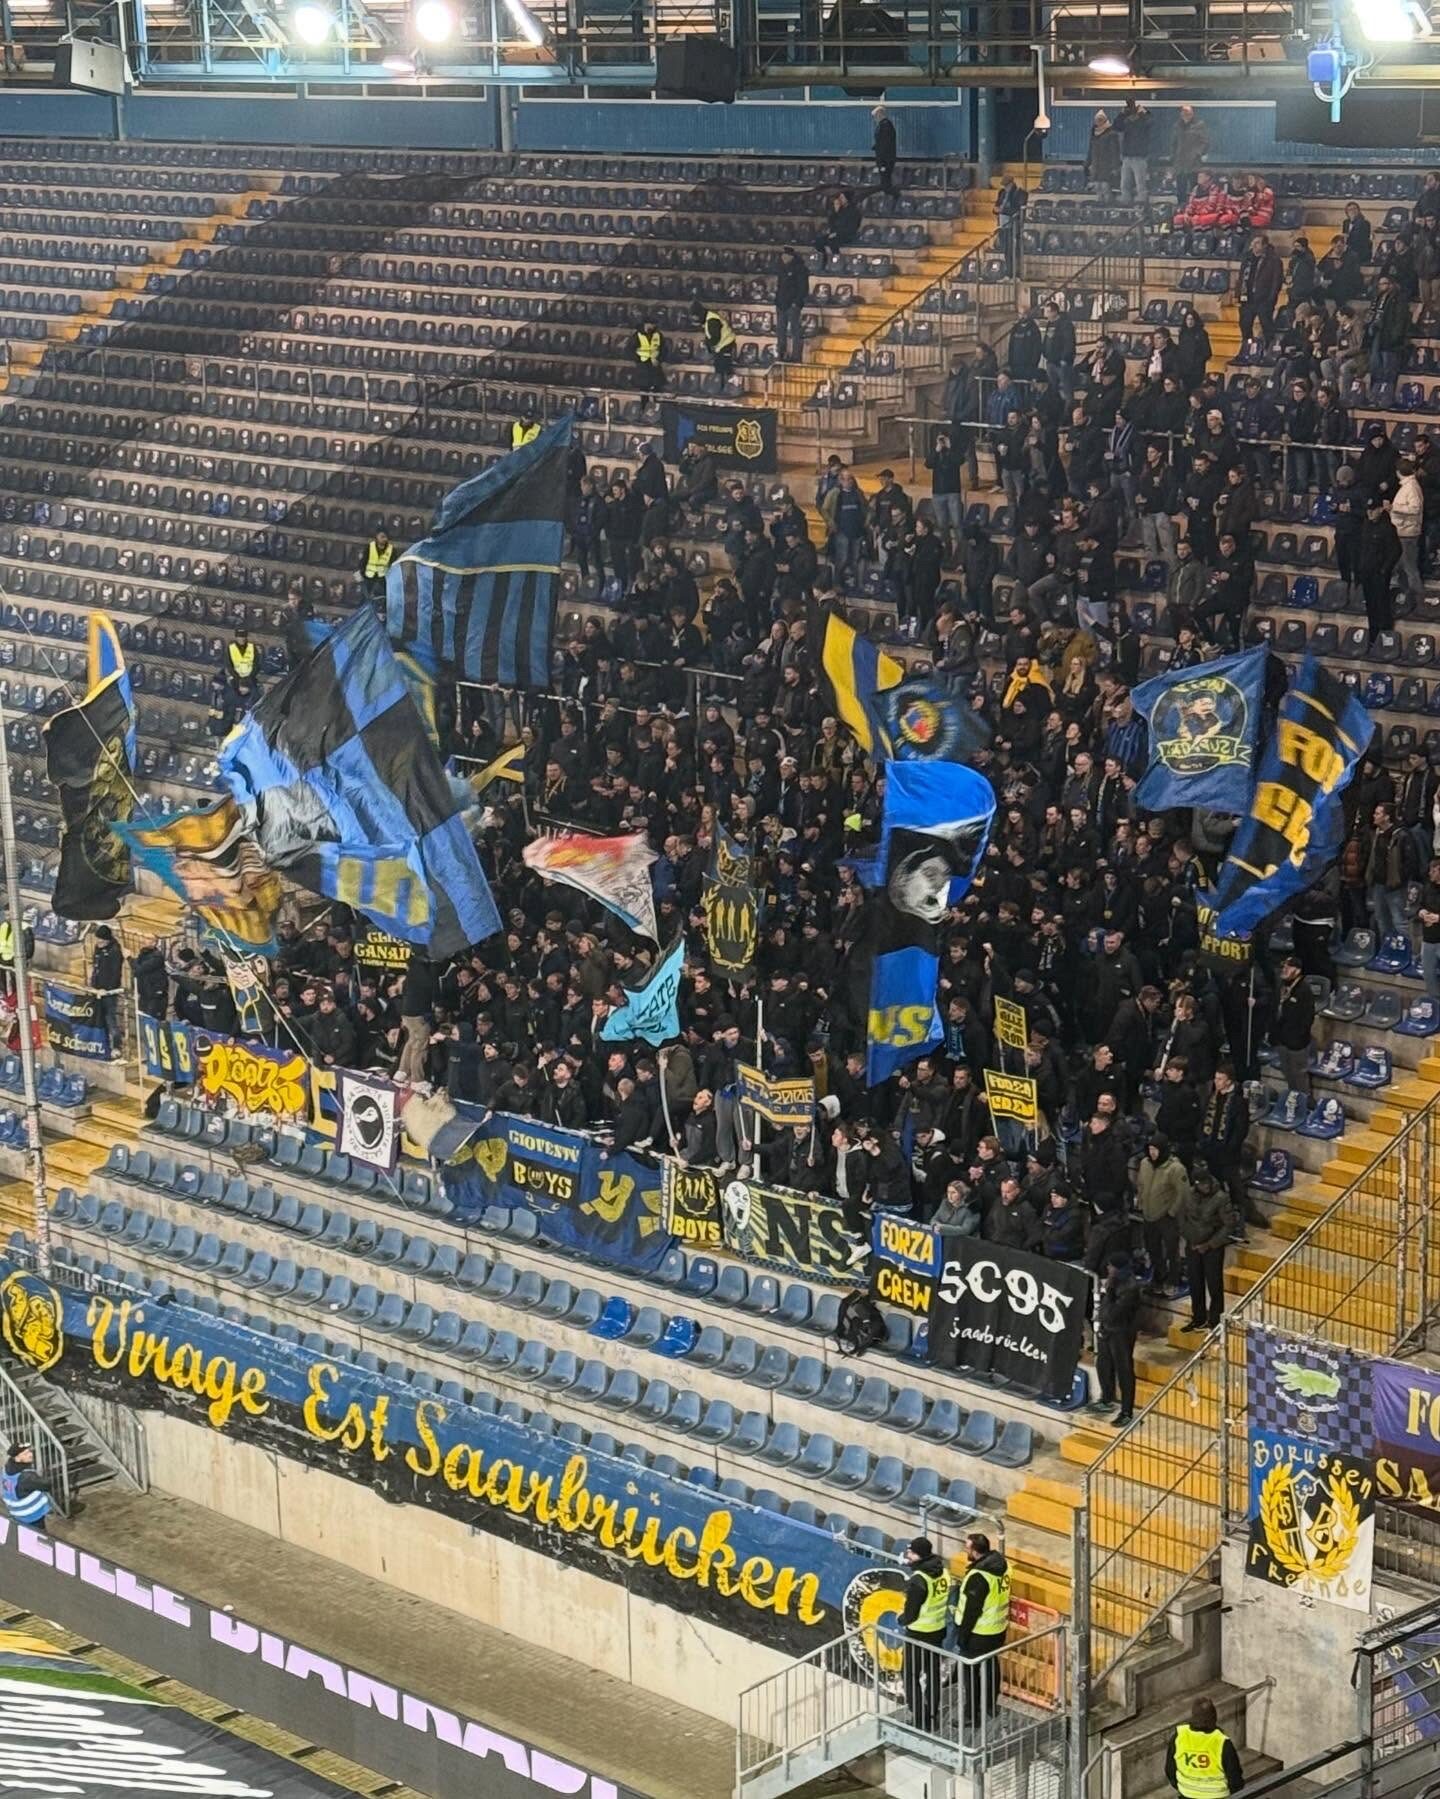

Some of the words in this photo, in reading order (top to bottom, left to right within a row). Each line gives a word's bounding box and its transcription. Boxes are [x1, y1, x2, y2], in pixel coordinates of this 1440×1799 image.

[673, 1217, 721, 1242] BOYS
[880, 1218, 934, 1265] FORZA
[877, 1269, 931, 1312] CREW
[938, 1260, 1073, 1333] SC95
[86, 1296, 270, 1427] Virage
[303, 1363, 391, 1461] Est
[406, 1399, 826, 1626] Saarbrücken
[932, 1578, 948, 1598] K9
[1183, 1752, 1211, 1769] K9
